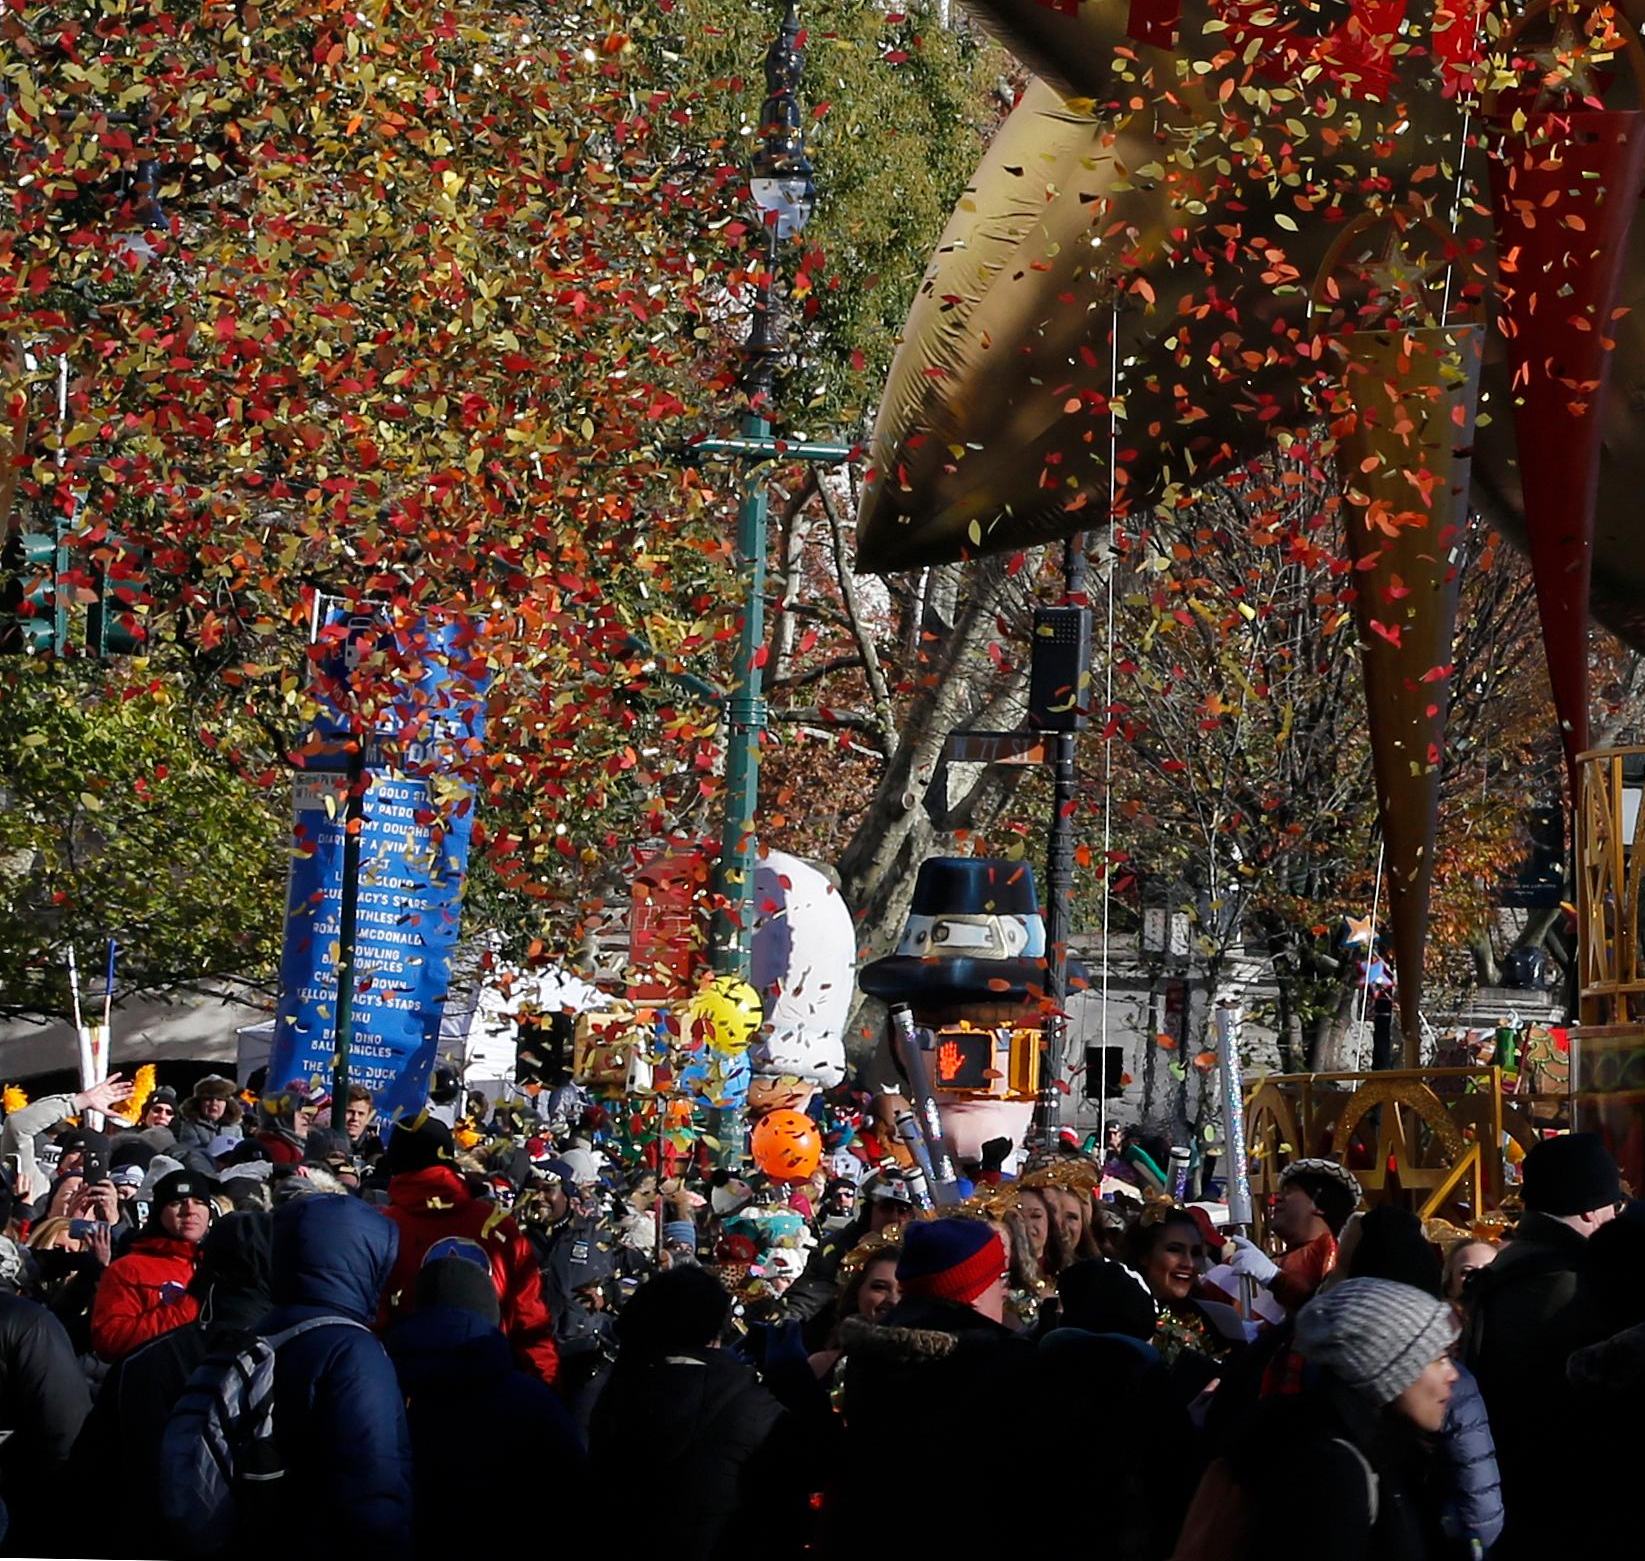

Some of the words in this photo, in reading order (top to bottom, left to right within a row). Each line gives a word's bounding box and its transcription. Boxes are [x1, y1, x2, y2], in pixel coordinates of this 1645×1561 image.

[378, 787, 409, 800] GOLD
[378, 807, 414, 819] PATRO
[383, 822, 430, 838] DOUGHB
[357, 892, 389, 905] ACY'S
[312, 923, 341, 935] RONA
[355, 945, 400, 961] OWLING
[371, 978, 407, 990] ROWN
[351, 993, 383, 1007] ACY'S
[386, 998, 422, 1011] STARS
[302, 1060, 324, 1072] THE
[366, 1067, 397, 1080] DUCK
